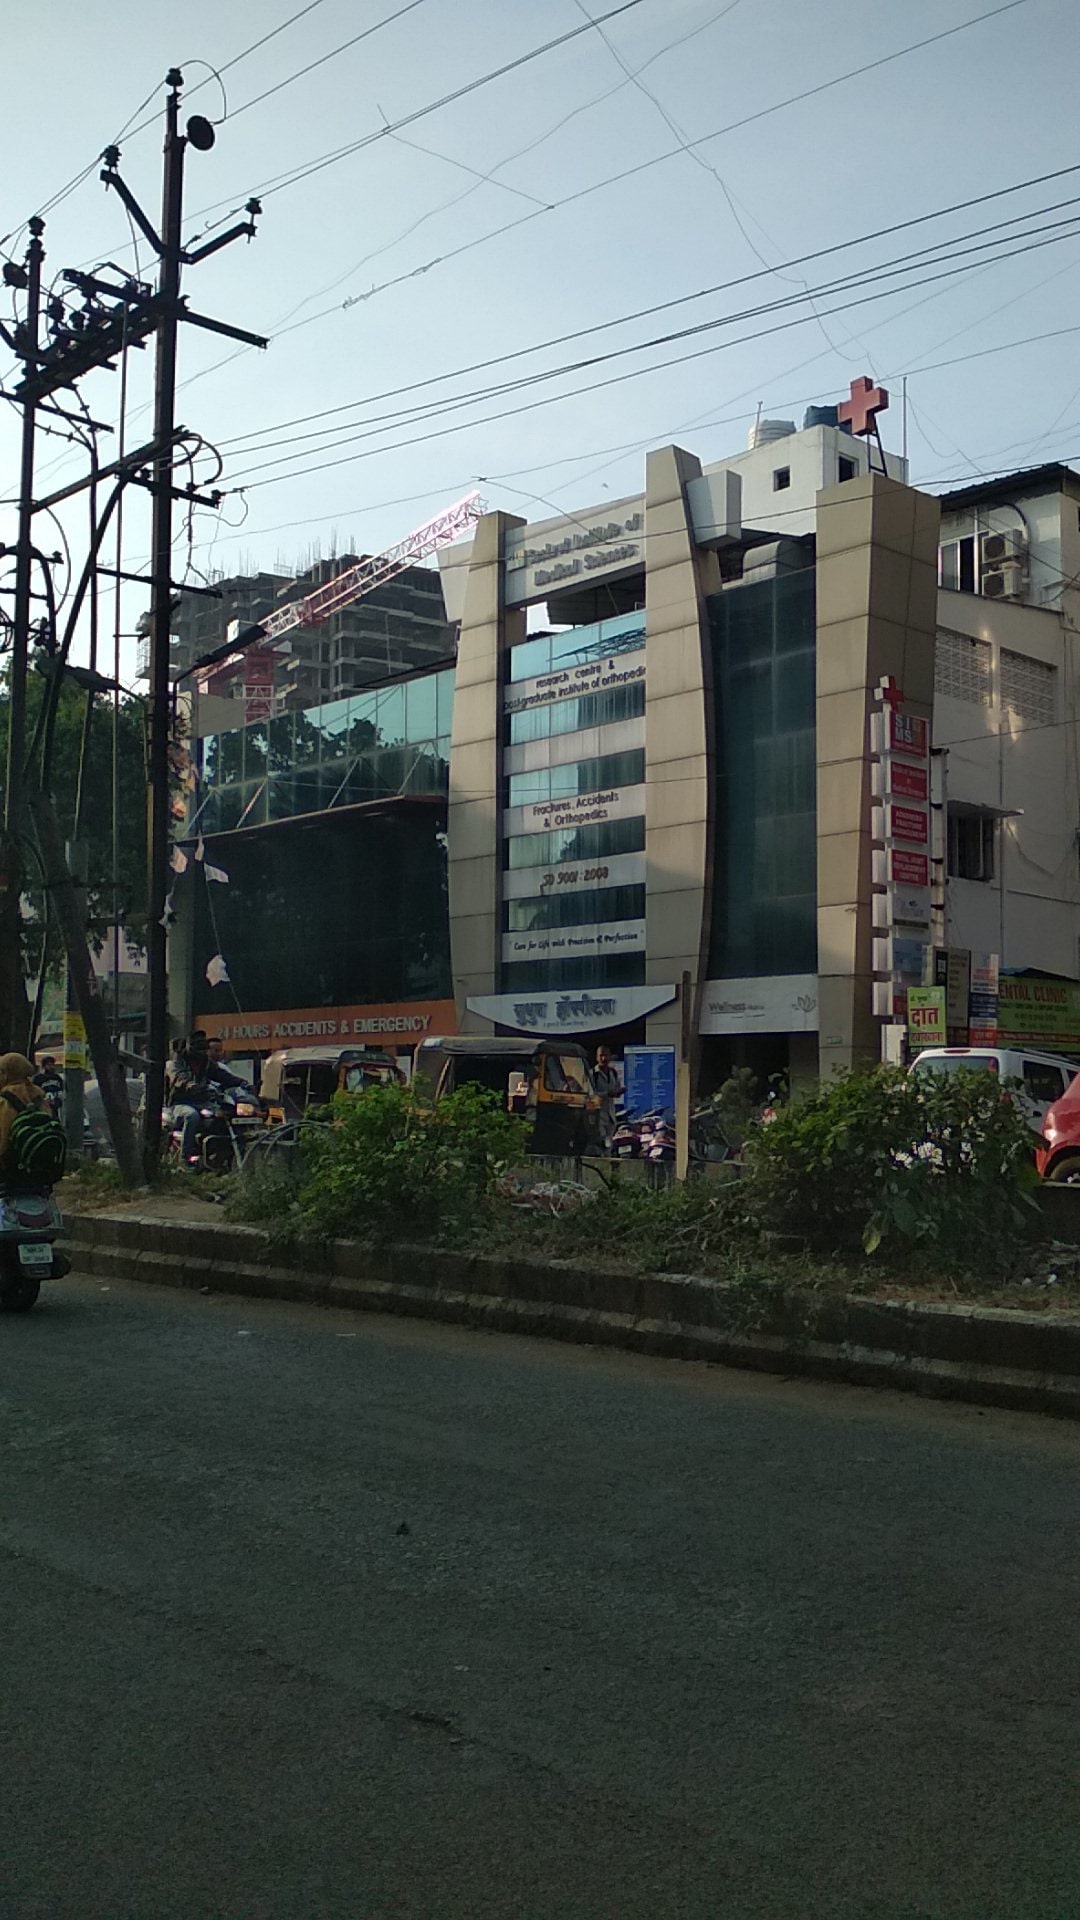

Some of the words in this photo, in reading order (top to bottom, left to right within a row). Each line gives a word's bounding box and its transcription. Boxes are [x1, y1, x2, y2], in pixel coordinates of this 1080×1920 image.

[536, 672, 569, 688] research
[575, 664, 601, 679] centre
[608, 659, 615, 670] &
[558, 680, 590, 697] institute
[591, 674, 600, 688] of
[576, 791, 619, 808] Accidents
[544, 818, 550, 827] &
[555, 808, 608, 825] Orthopedics
[527, 940, 537, 951] for
[568, 936, 595, 947] Precision
[604, 932, 638, 944] Perfection
[233, 1024, 269, 1039] HOURS
[273, 1019, 337, 1037] ACCIDENTS
[340, 1019, 349, 1034] &
[353, 1014, 431, 1034] EMERGENCY
